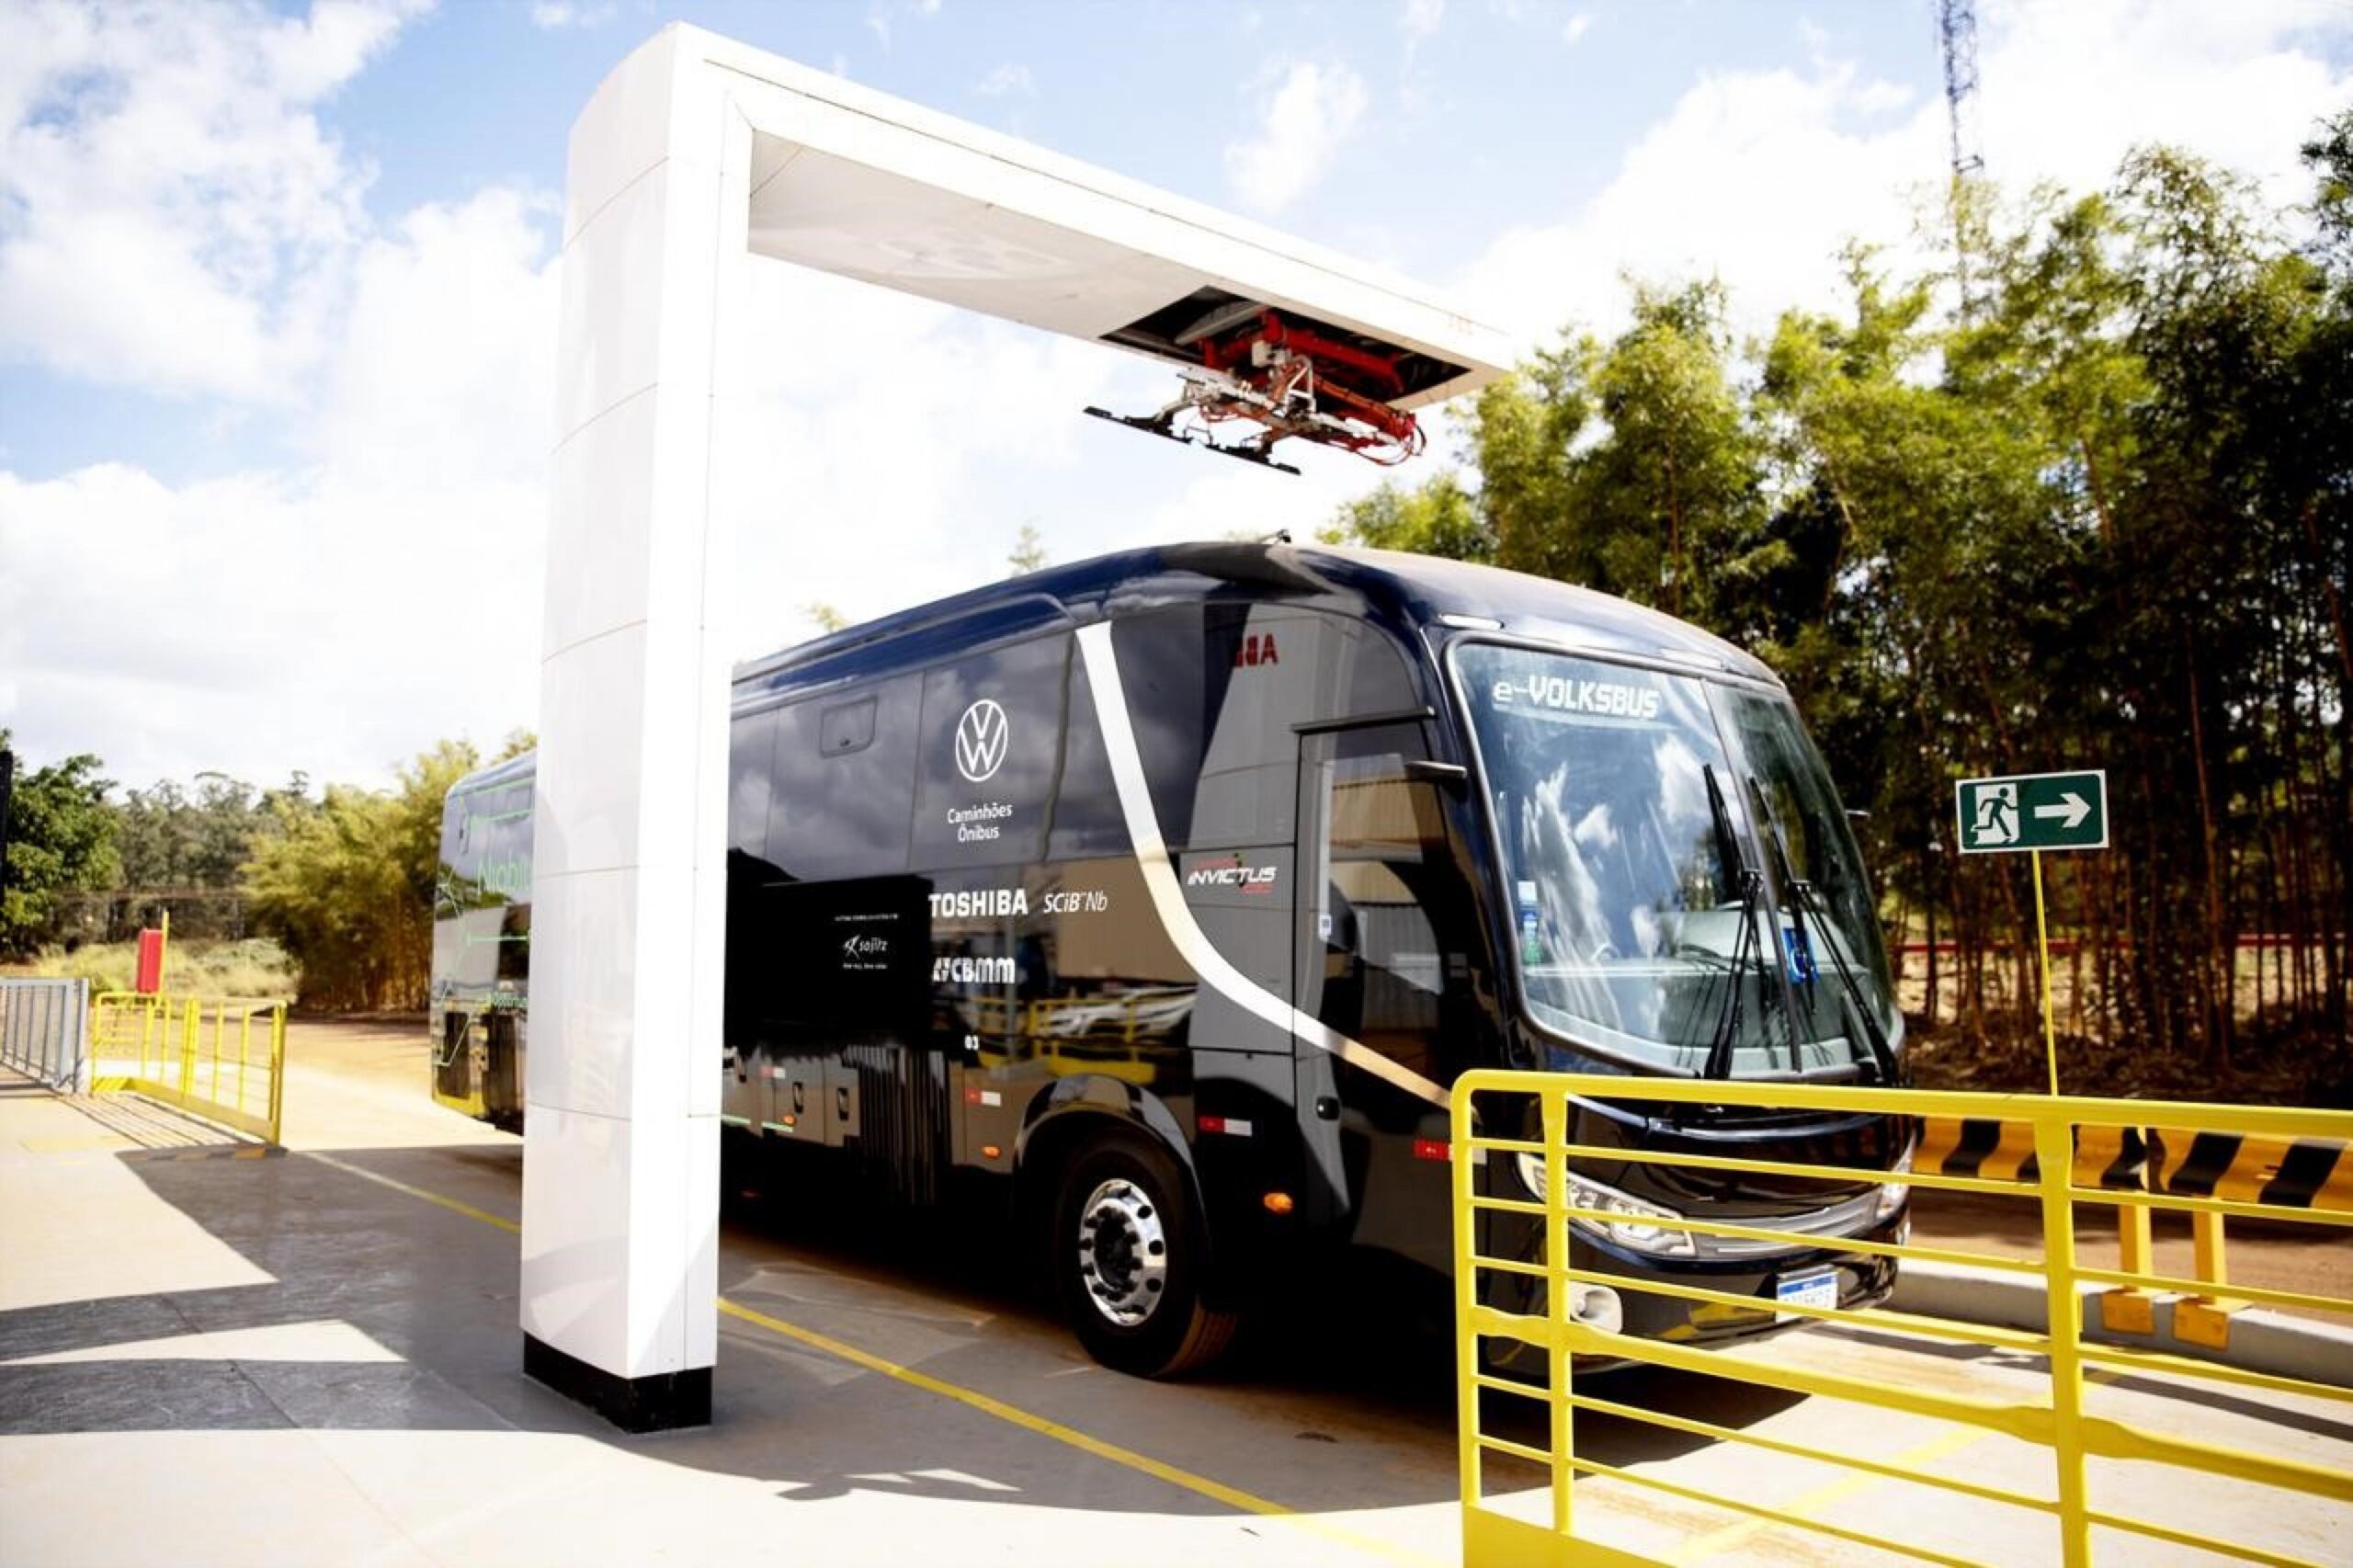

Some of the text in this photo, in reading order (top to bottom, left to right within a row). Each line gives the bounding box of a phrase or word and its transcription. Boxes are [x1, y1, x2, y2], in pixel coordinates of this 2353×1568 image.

[1492, 674, 1661, 718] e-VOLKSBUS
[947, 801, 1014, 824] Caminhões
[957, 823, 1000, 842] Ônibus
[1187, 867, 1278, 885] INVICTUS
[928, 888, 1029, 917] TOSHIBA
